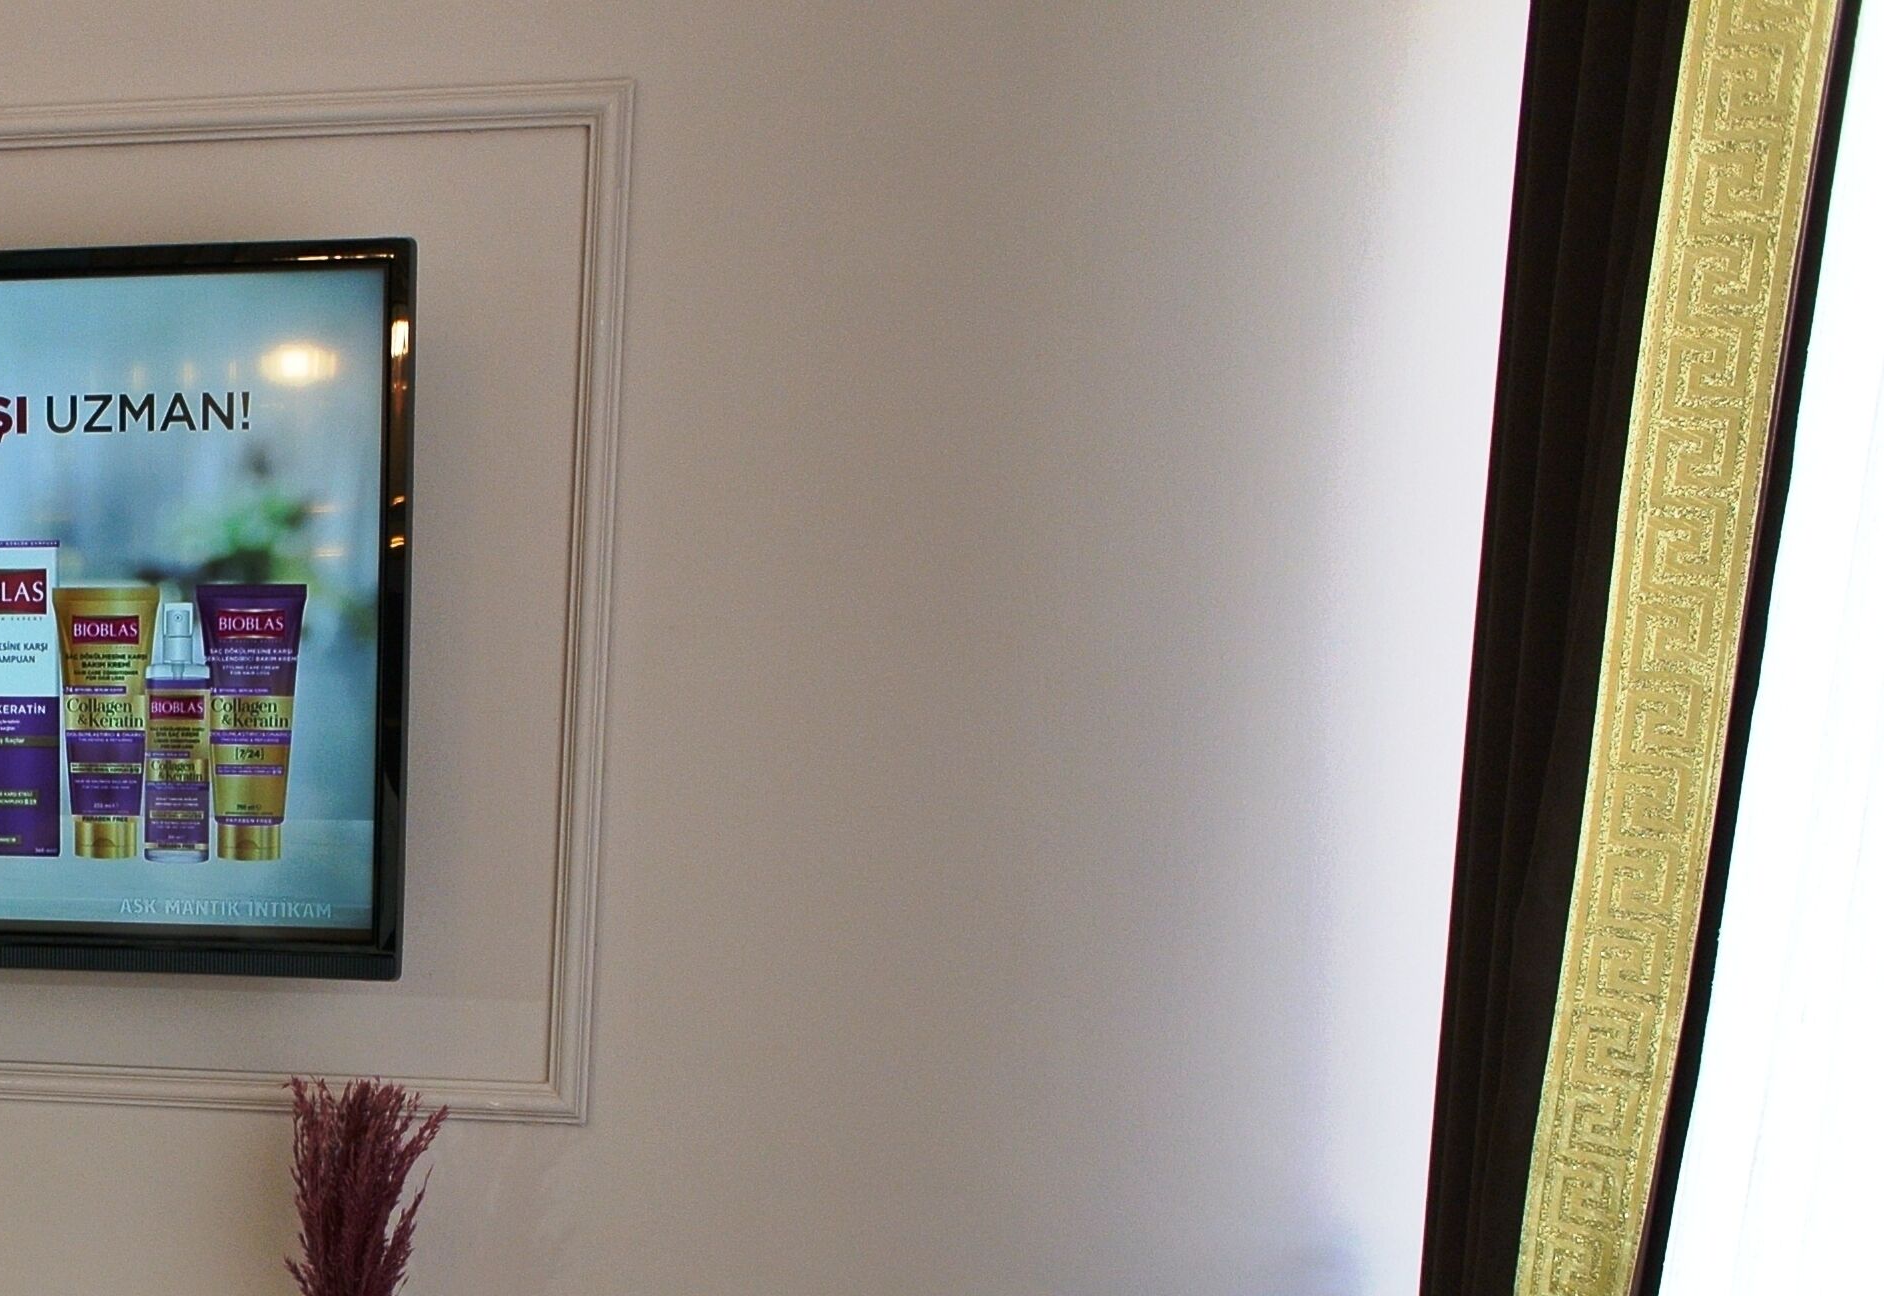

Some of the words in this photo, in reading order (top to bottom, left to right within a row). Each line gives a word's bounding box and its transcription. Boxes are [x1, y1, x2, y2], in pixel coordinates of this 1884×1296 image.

[46, 391, 251, 434] UZMAN!
[73, 623, 138, 637] BIOBLAS
[219, 616, 284, 631] BIOBLAS
[24, 643, 48, 652] KARŞI
[67, 698, 133, 717] Collagen
[151, 701, 204, 713] BIOBLAS
[211, 698, 278, 716] Collagen
[165, 898, 241, 918] MANTIK
